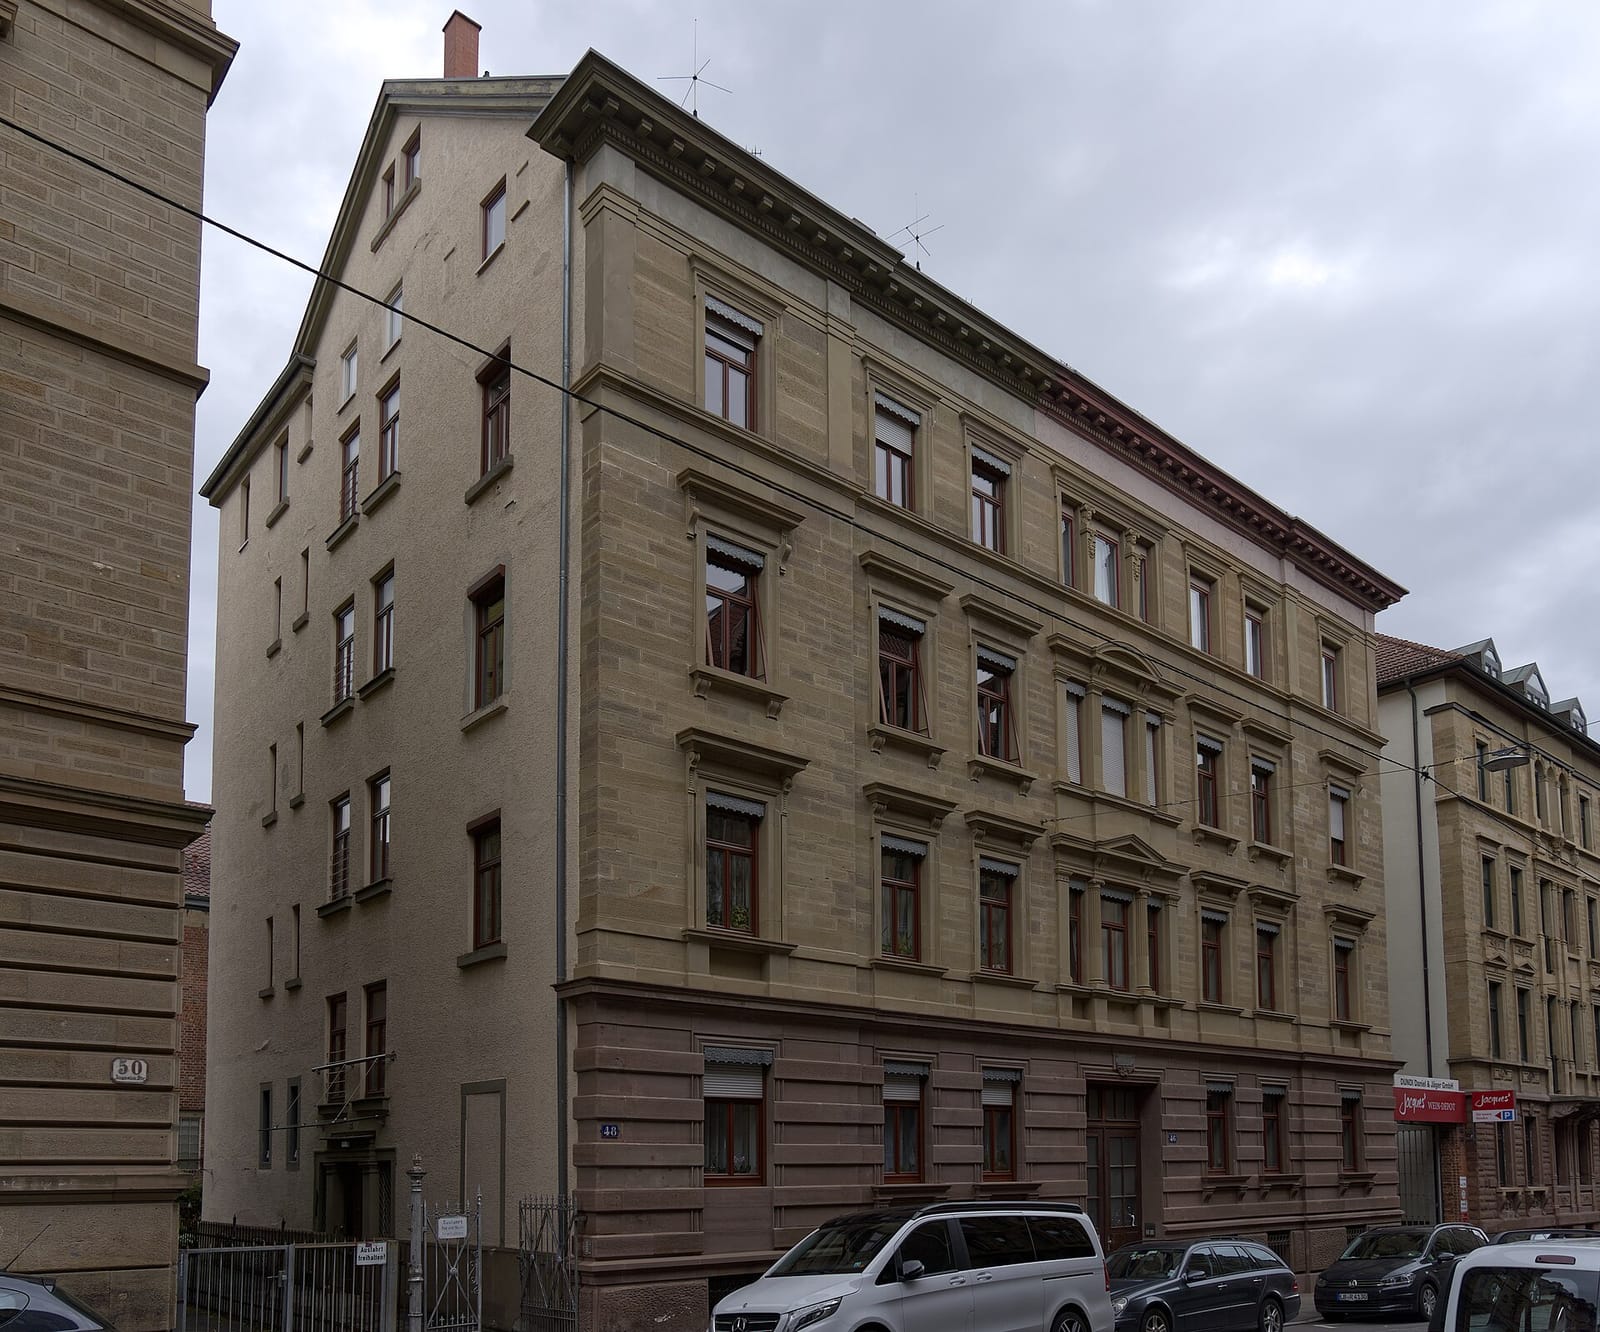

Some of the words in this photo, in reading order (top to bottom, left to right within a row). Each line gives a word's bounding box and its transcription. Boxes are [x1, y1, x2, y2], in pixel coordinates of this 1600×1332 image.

[118, 1059, 143, 1076] 50
[1414, 1079, 1426, 1088] Daniel
[1442, 1081, 1454, 1090] GmbH
[1427, 1101, 1456, 1112] WEIN-DEPOT
[603, 1126, 617, 1136] 48
[357, 1253, 386, 1262] freihalten!
